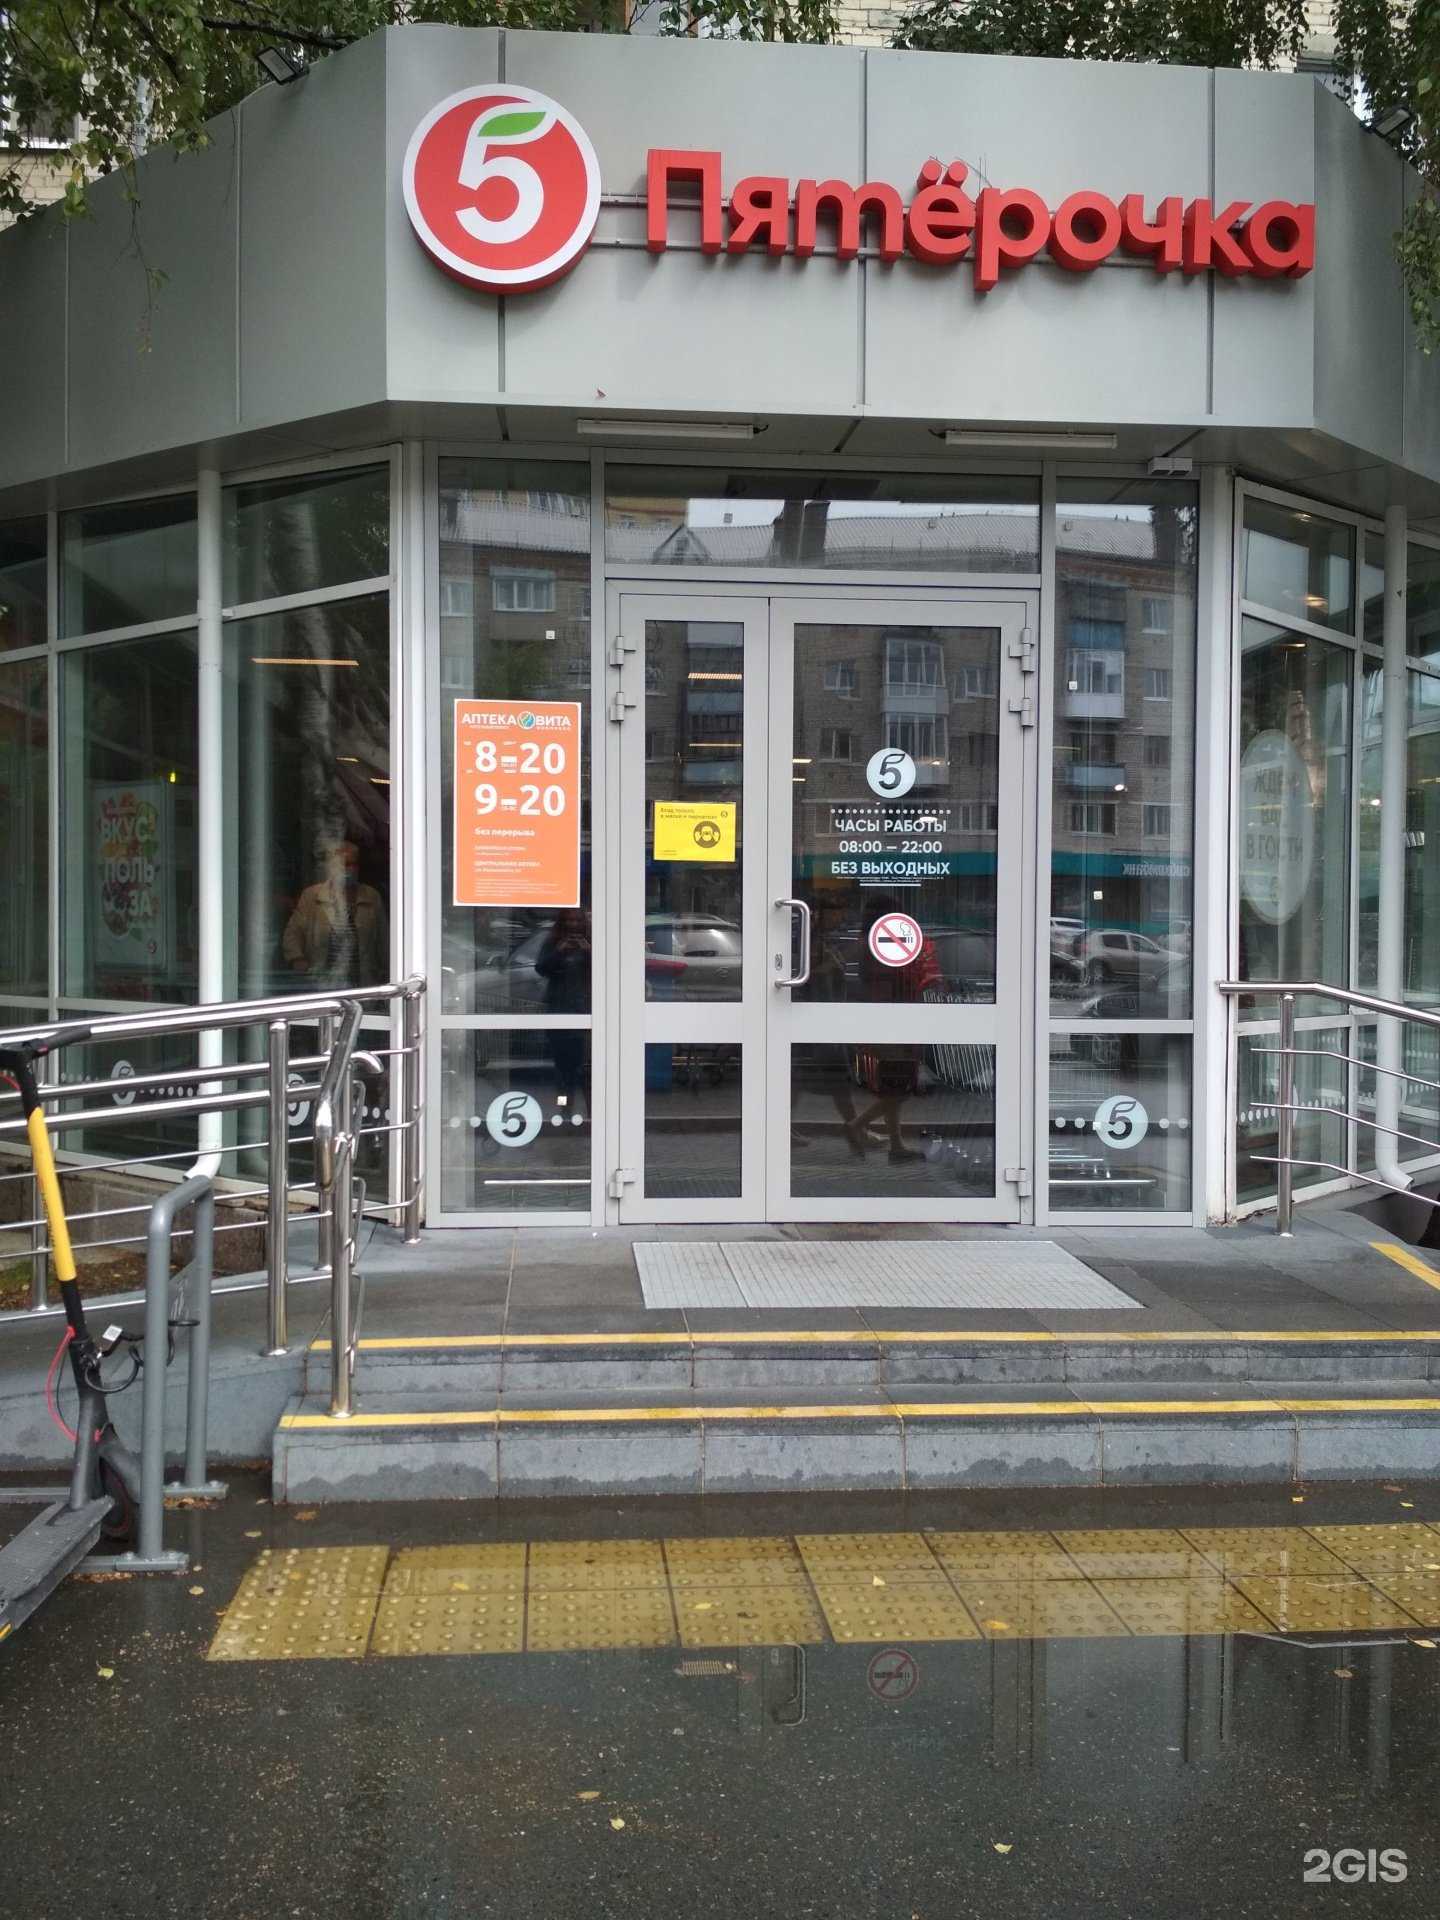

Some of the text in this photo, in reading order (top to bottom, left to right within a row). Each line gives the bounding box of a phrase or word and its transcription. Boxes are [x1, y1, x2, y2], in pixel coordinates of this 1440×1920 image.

[648, 148, 1315, 292] Пятёрочка
[462, 713, 571, 727] АПТЕКА ВИТА
[835, 819, 946, 832] ЧАСЫ РАБОТЫ
[839, 841, 882, 853] 08:00
[901, 841, 943, 853] 22:00
[831, 861, 950, 876] БЕЗ ВЫХОДНЫХ
